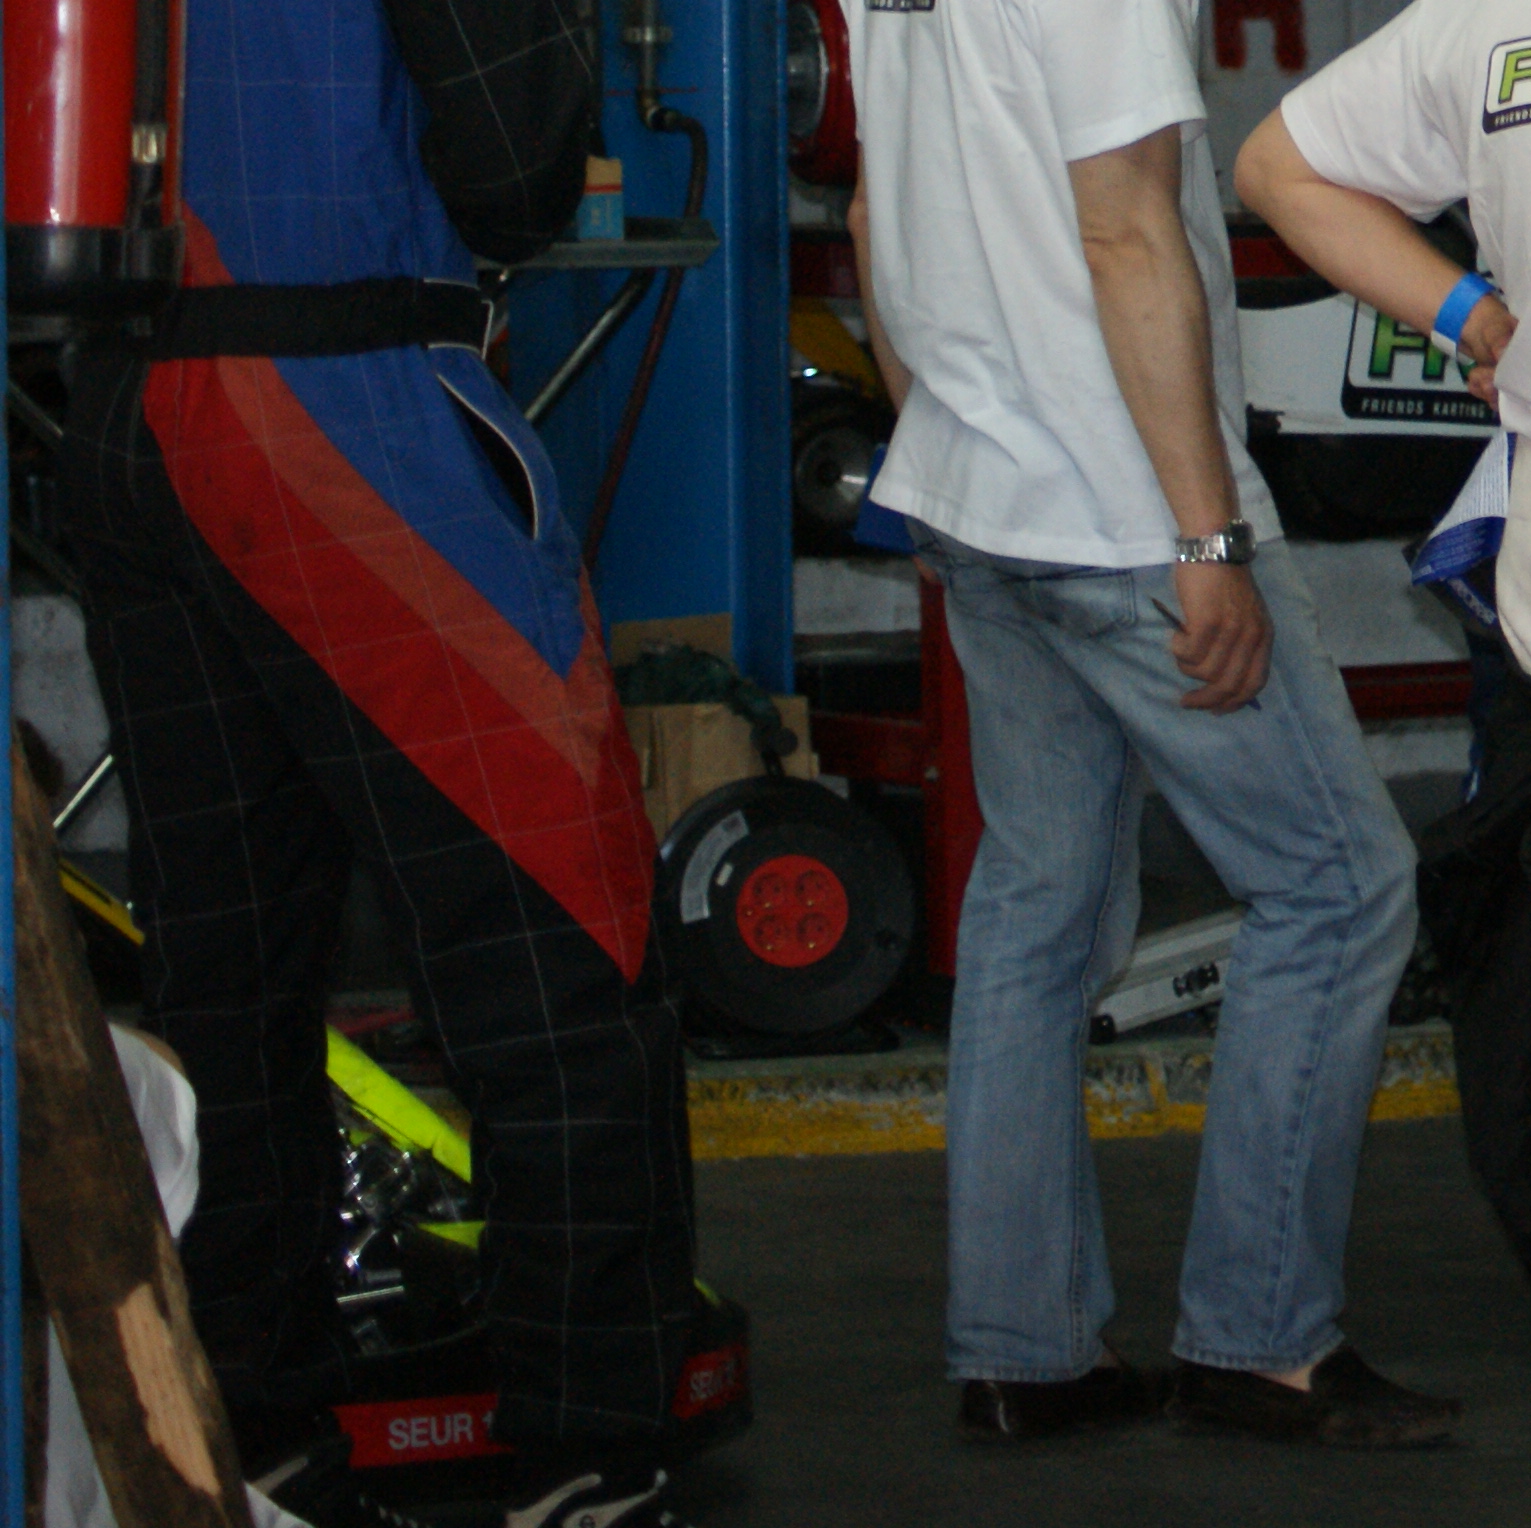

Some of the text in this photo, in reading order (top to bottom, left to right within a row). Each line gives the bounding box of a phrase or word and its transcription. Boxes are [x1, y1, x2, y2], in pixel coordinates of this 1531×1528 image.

[1361, 397, 1486, 419] FRIENDS KARTING
[388, 1411, 475, 1451] SEUR
